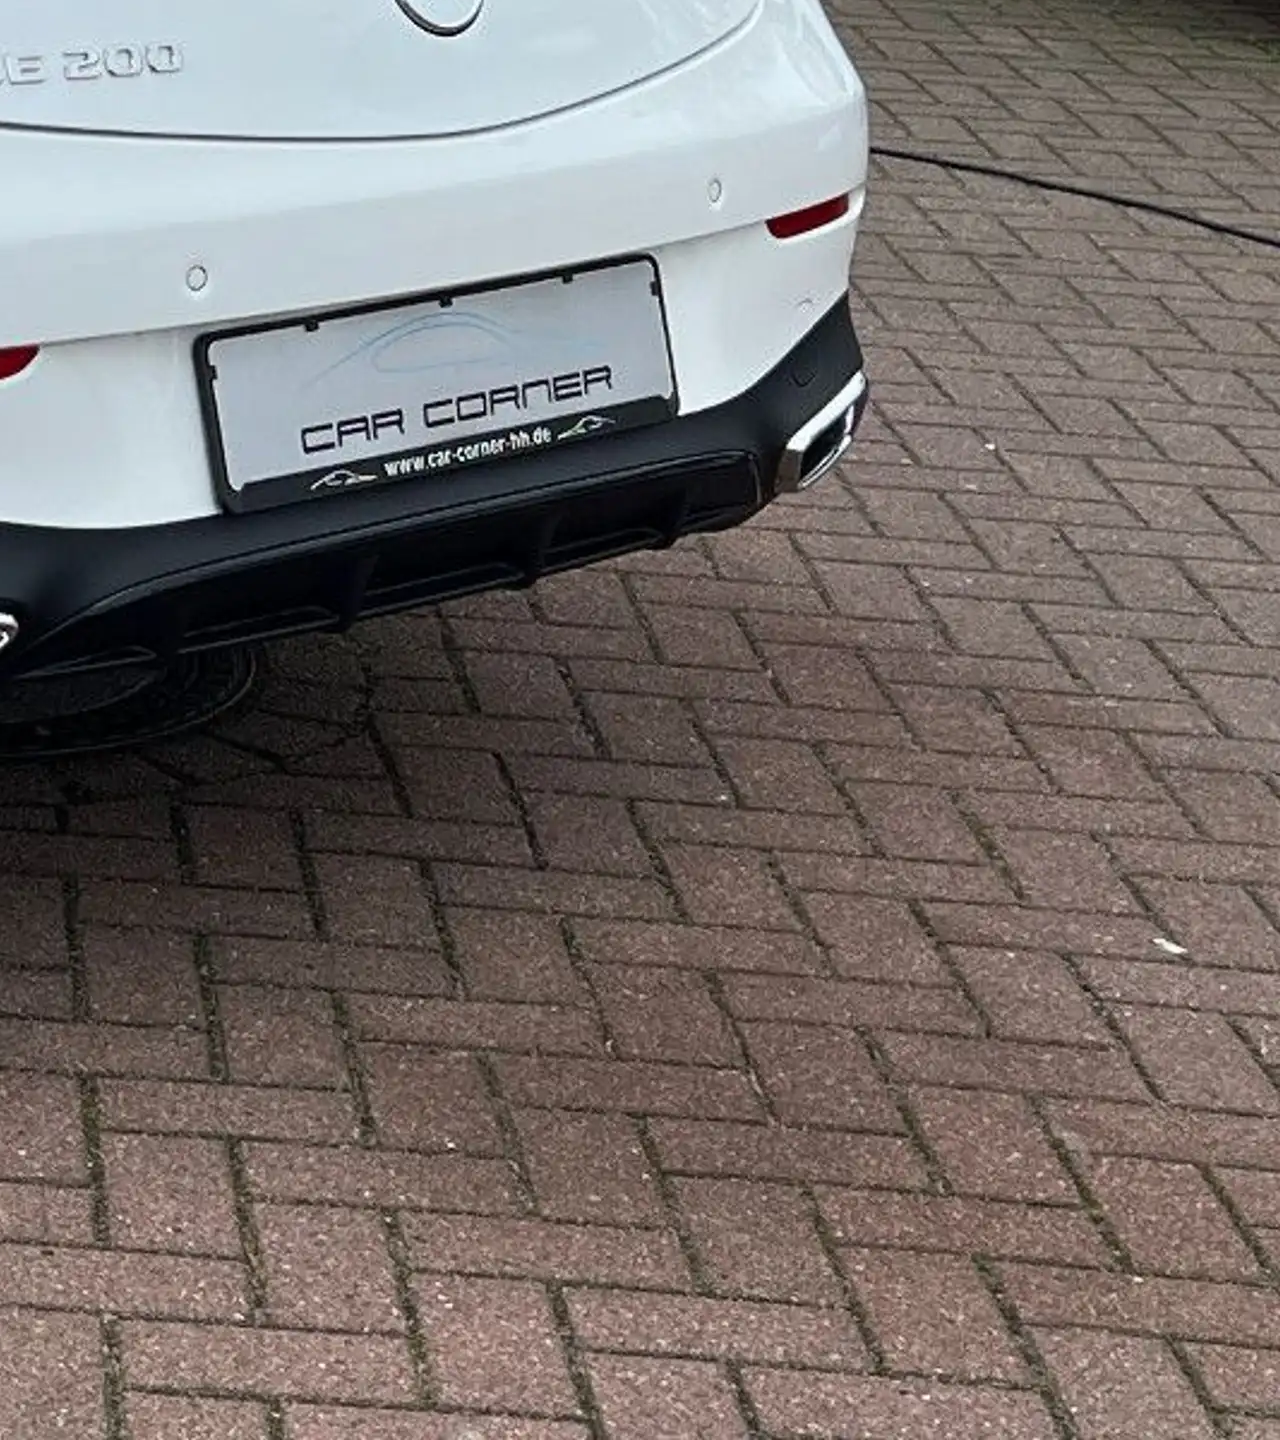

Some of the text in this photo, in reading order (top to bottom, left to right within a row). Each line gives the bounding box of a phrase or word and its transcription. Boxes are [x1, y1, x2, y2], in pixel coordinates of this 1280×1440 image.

[61, 42, 184, 81] 200
[300, 364, 613, 455] CAR CORNER
[383, 425, 553, 477] www.car-corner-hh.de
